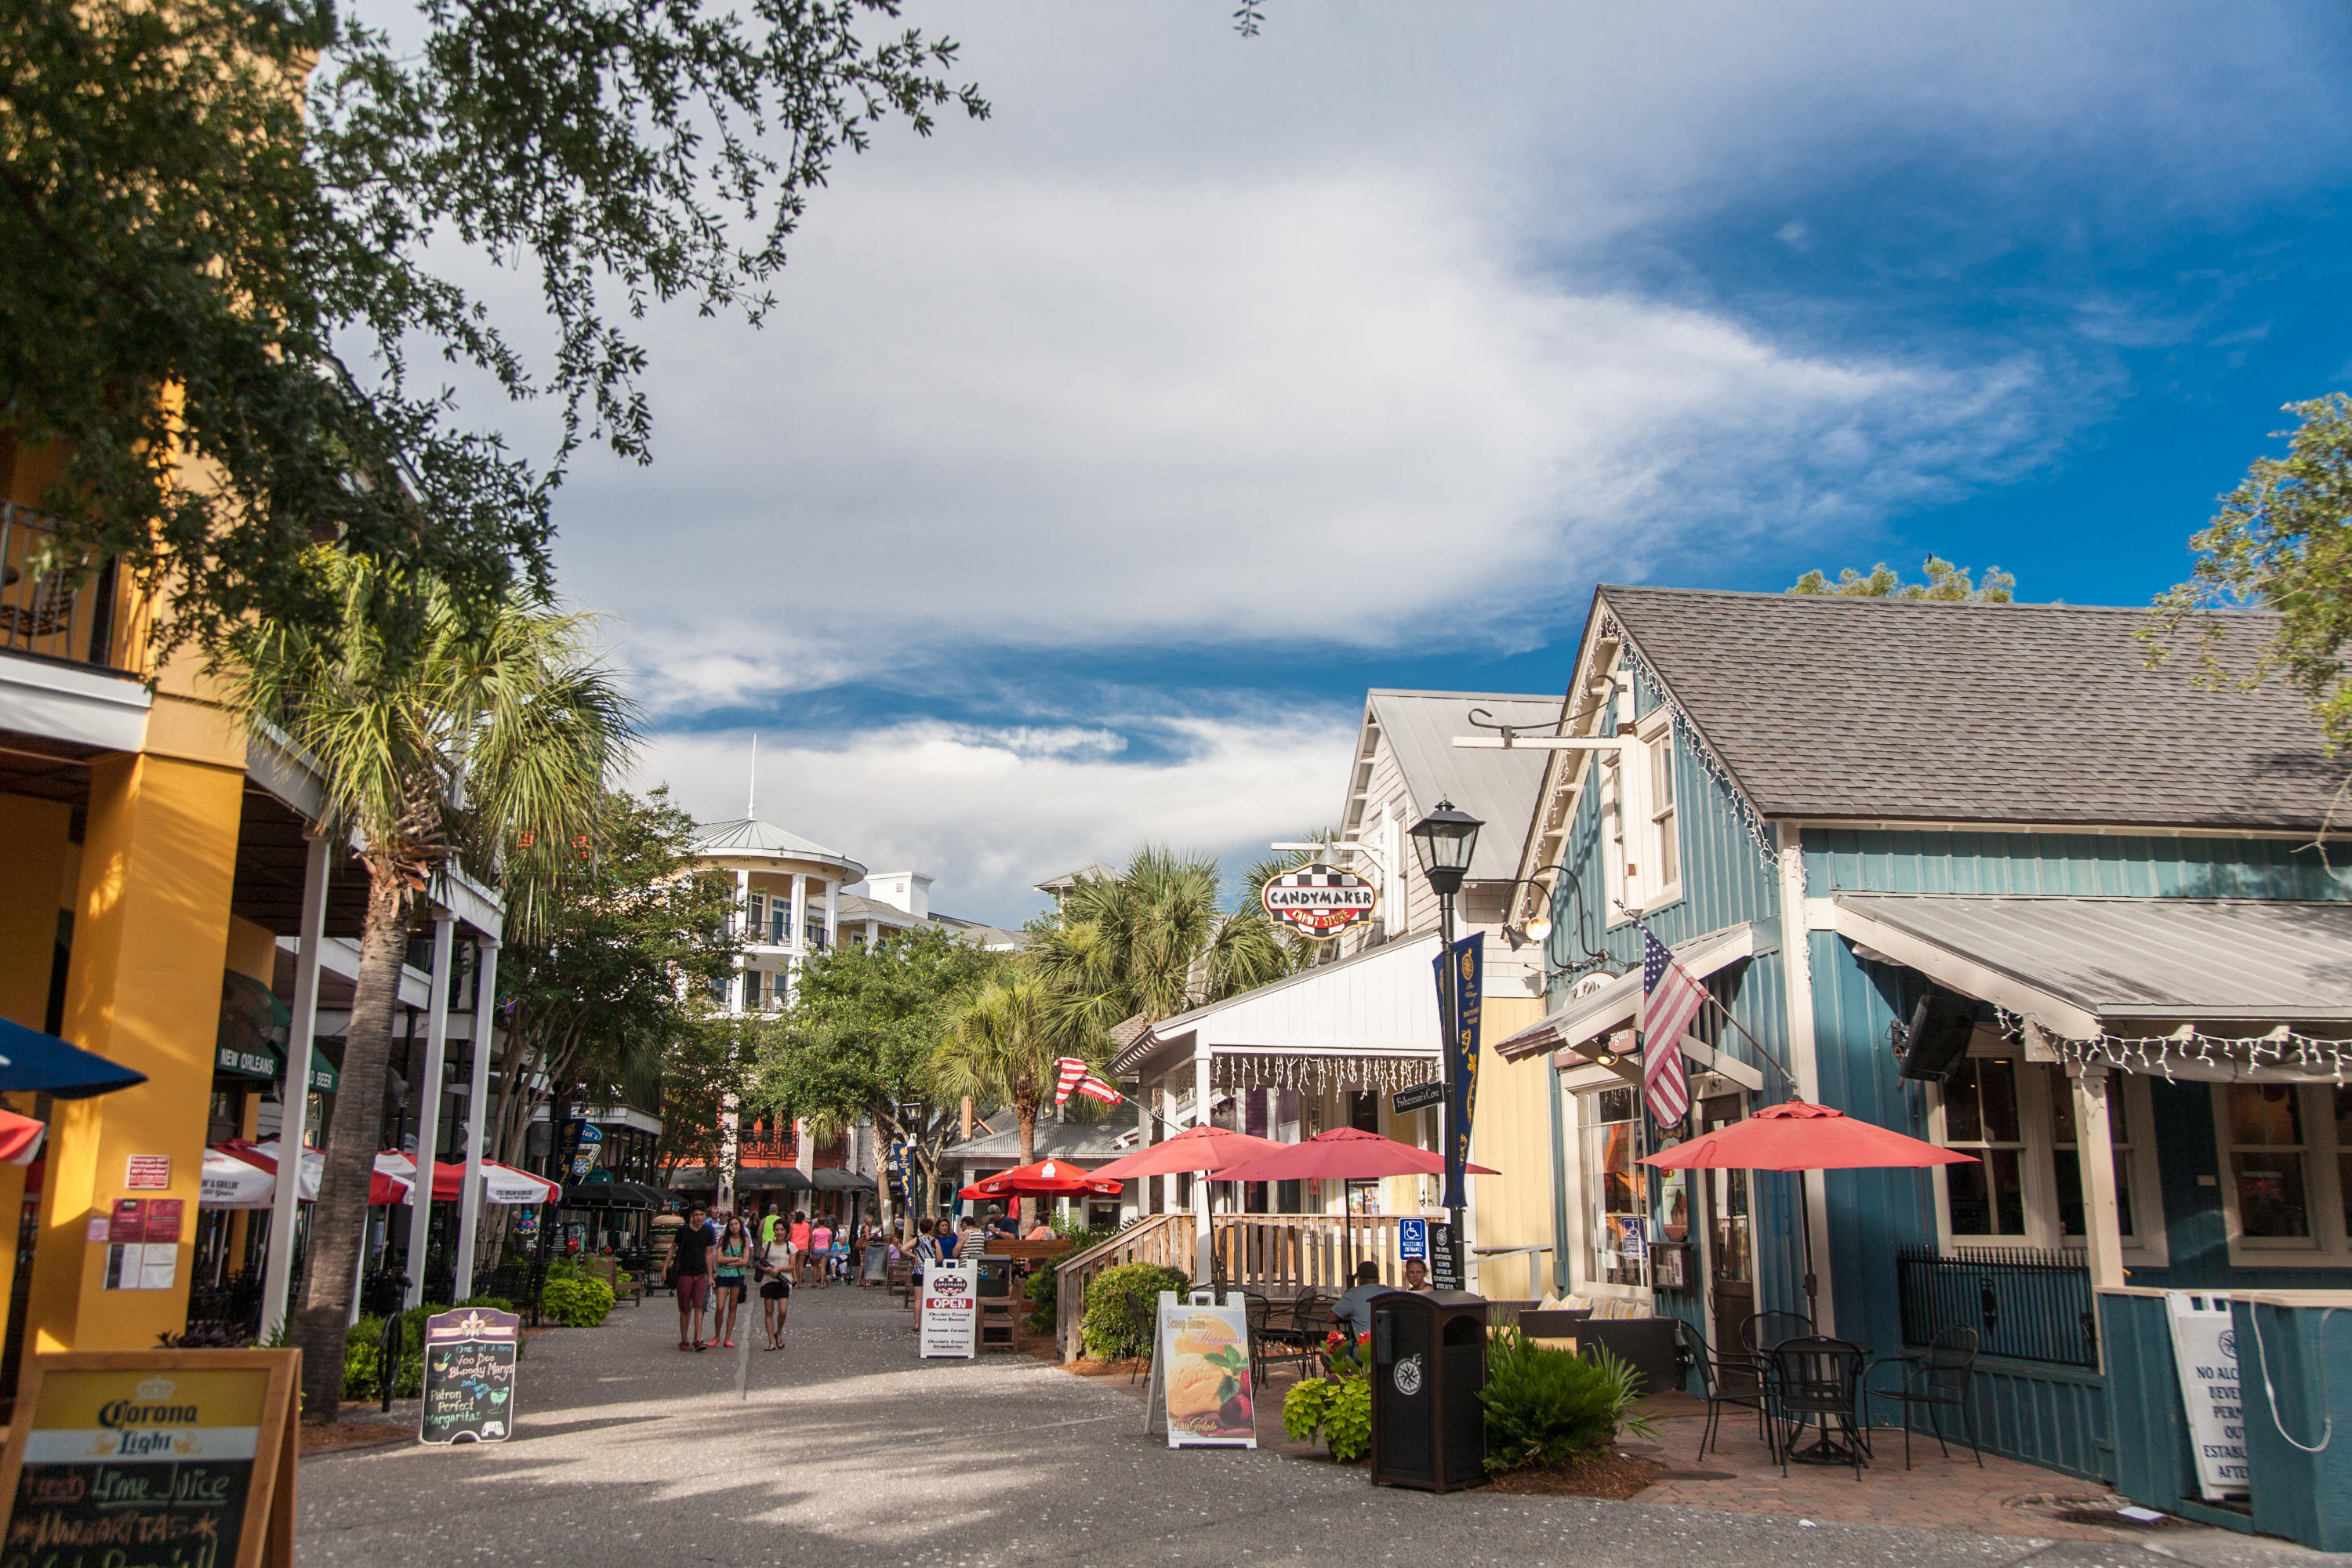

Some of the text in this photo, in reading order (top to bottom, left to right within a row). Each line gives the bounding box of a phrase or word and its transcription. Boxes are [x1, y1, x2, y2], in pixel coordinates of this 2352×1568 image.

[1271, 891, 1372, 905] CANDYMAKER
[1323, 909, 1351, 926] STORE
[220, 1048, 274, 1075] NEW ORLEANS
[316, 1072, 332, 1089] BEER
[1396, 1088, 1439, 1108] Fisherman's Cove
[933, 1298, 966, 1308] OPEN
[1167, 1316, 1186, 1333] Scoop
[478, 1343, 487, 1352] of
[1193, 1330, 1243, 1348] Happiness
[2195, 1367, 2239, 1380] NO ALC
[430, 1388, 462, 1401] Patron
[2208, 1386, 2241, 1399] BEVE
[438, 1396, 474, 1413] Perfect
[98, 1399, 198, 1429] Corona
[425, 1410, 481, 1429] Margaritas
[1186, 1417, 1218, 1435] Gelato
[118, 1430, 172, 1455] Light
[2202, 1445, 2248, 1458] ESTABL
[2218, 1465, 2249, 1479] AFTE
